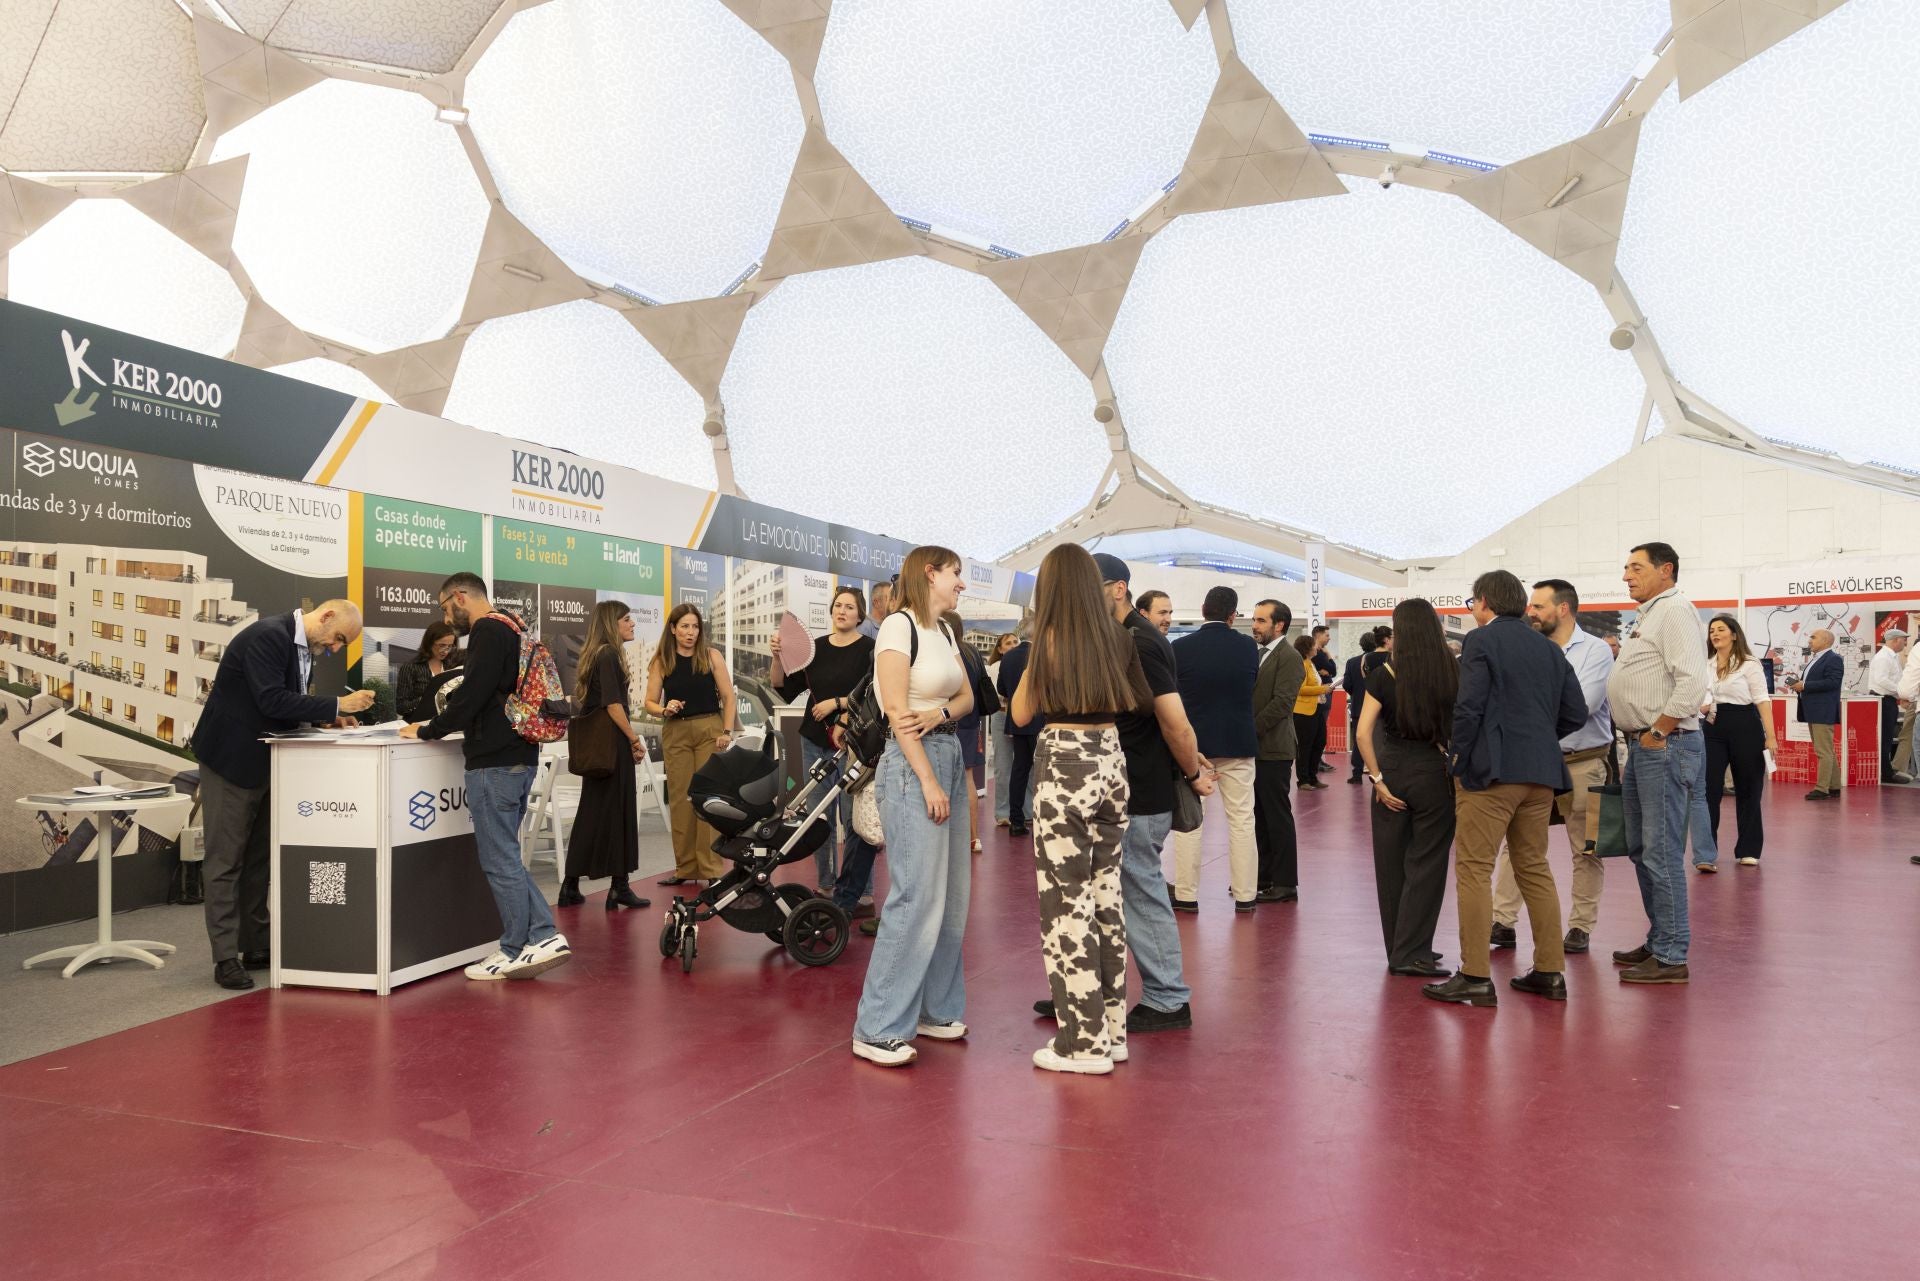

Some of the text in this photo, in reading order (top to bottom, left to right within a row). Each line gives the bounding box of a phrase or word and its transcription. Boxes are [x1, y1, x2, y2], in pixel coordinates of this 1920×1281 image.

[112, 358, 222, 408] KER 2000
[113, 397, 218, 429] INMOBILIARIA
[59, 447, 138, 478] SUQUIA
[94, 476, 139, 490] HOMES
[512, 449, 604, 500] KER 2000
[44, 493, 64, 513] de
[68, 500, 77, 515] 3
[80, 504, 91, 522] y
[95, 503, 103, 519] 4
[107, 502, 191, 529] dormitorios
[216, 485, 342, 520] PARQUE NUEVO
[512, 496, 601, 525] INMOBILIARIA
[375, 506, 446, 530] Casas donde
[238, 526, 270, 537] Viviendas
[272, 530, 280, 538] de
[305, 534, 337, 544] dormitorios
[375, 528, 467, 553] apetece vivir
[502, 525, 547, 546] Fases 2 ya
[742, 518, 758, 543] LA
[760, 523, 808, 553] EMOCIÓN
[810, 534, 823, 556] DE
[824, 537, 838, 559] UN
[515, 543, 568, 566] a la venta
[615, 543, 640, 566] land
[685, 556, 708, 574] Kyma
[639, 564, 653, 579] co
[380, 586, 431, 604] 163.000€
[1788, 576, 1903, 595] ENGEL&VÖLKERS
[550, 600, 584, 615] 193.000€
[315, 801, 358, 813] SUQUIA
